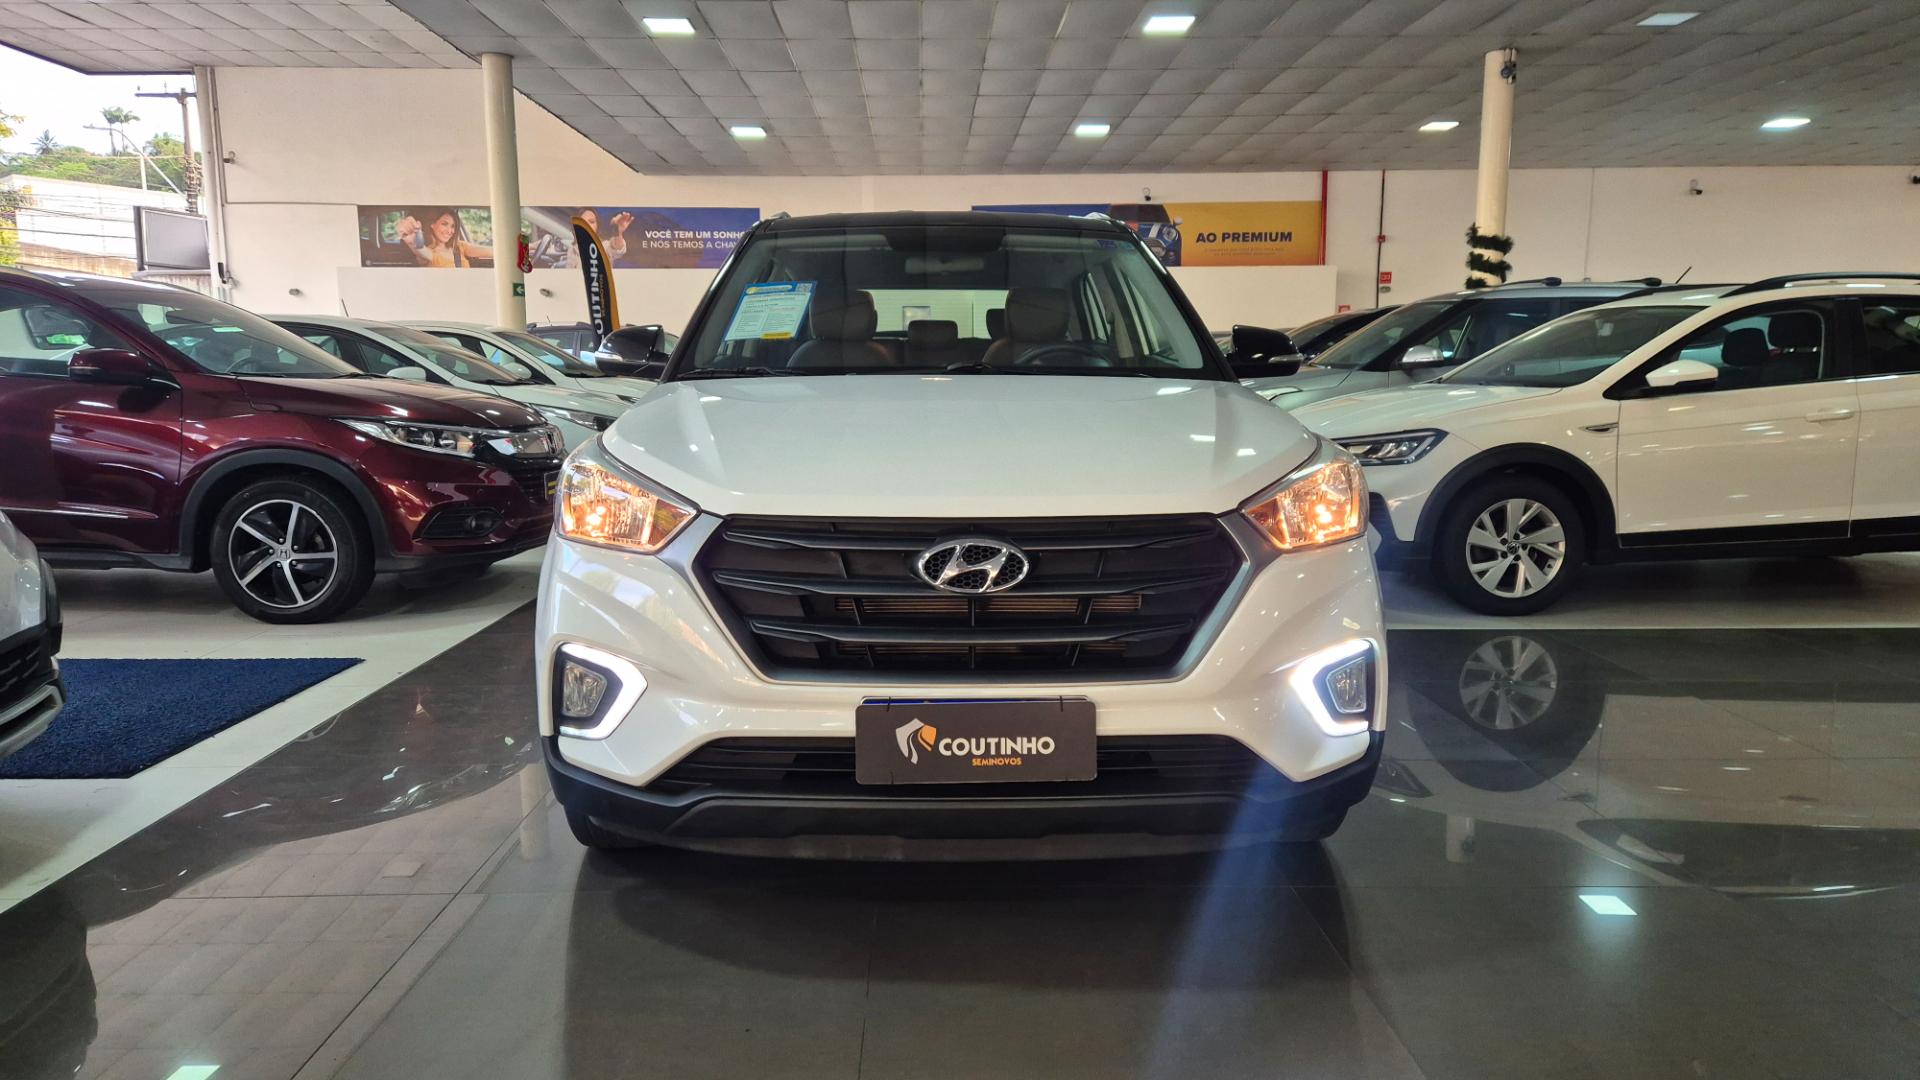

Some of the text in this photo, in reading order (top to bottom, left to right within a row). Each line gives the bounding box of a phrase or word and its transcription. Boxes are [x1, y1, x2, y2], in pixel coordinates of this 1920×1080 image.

[645, 229, 671, 239] VOCÊ
[674, 231, 693, 239] TEM
[696, 231, 711, 239] UM
[1196, 232, 1292, 243] AO PREMIUM
[650, 240, 670, 248] NÓS
[939, 737, 1055, 756] COUTINHO
[972, 757, 1022, 766] SEMINOVOS
